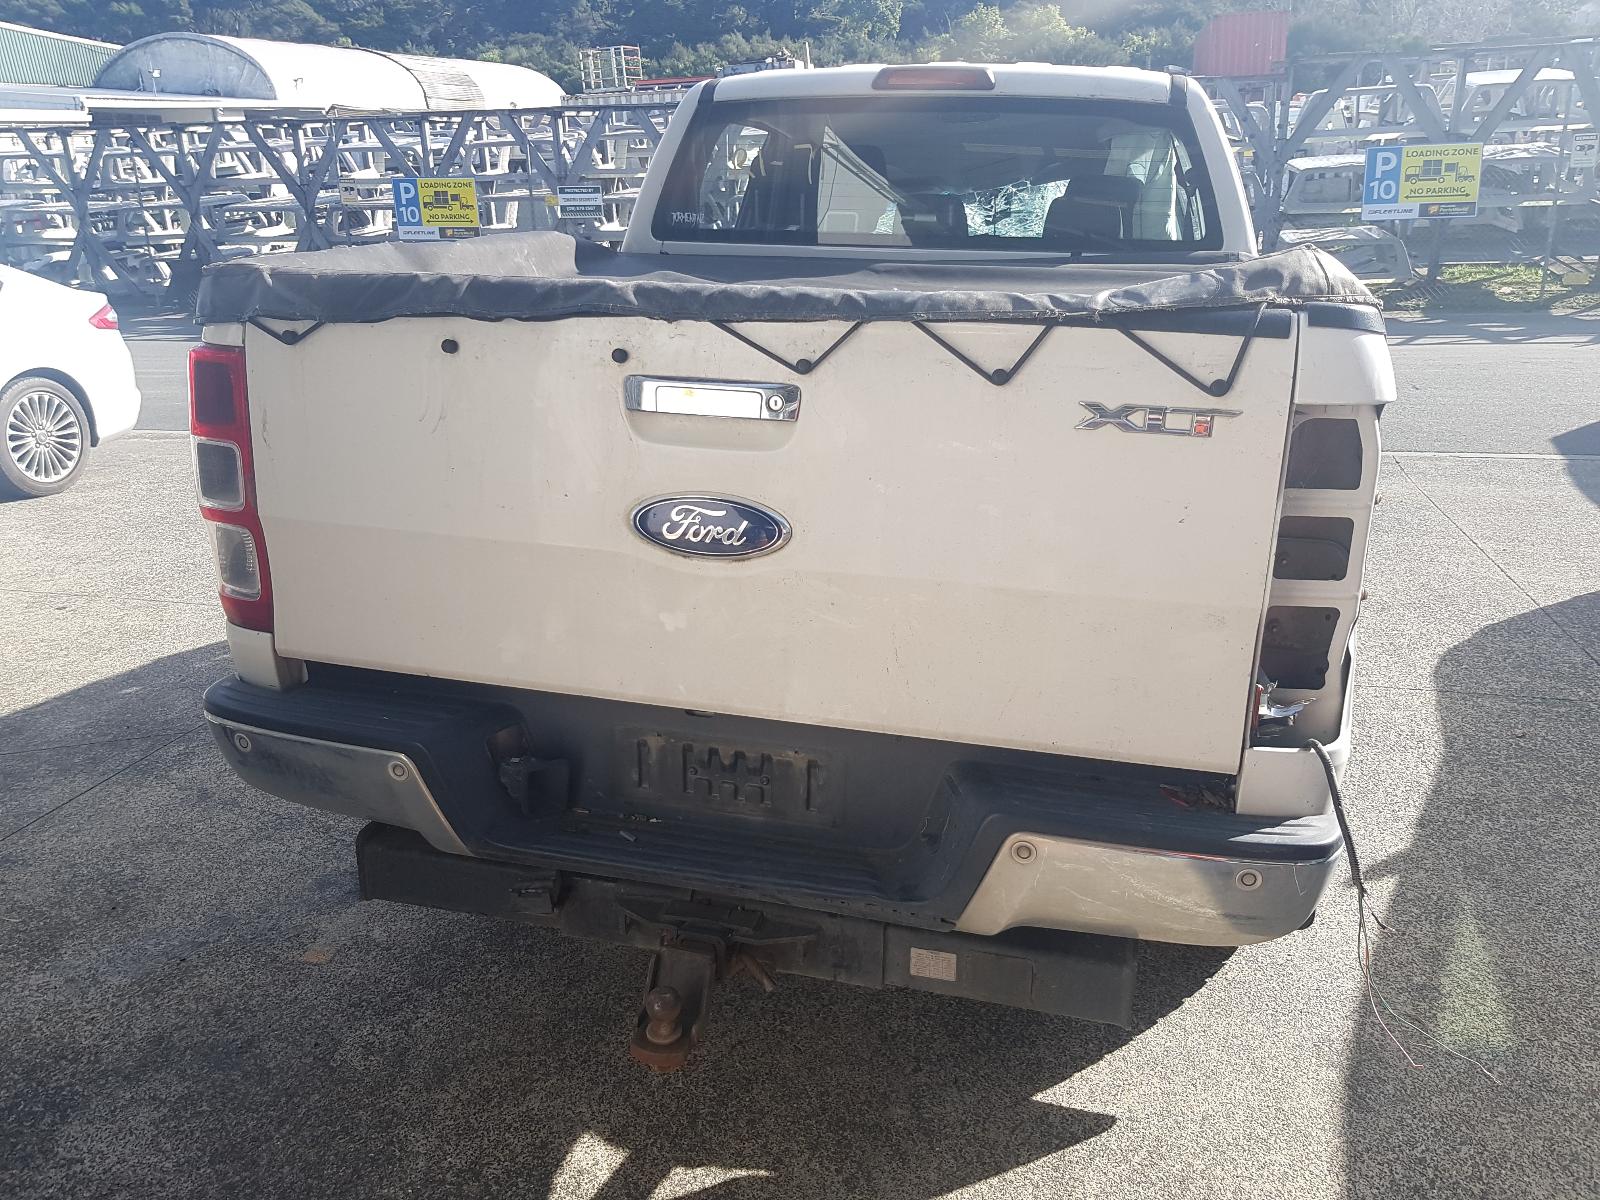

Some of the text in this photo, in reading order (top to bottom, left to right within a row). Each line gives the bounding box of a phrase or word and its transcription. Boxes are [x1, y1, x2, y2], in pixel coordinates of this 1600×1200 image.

[1406, 148, 1479, 158] LOADING ZONE
[1375, 151, 1398, 179] P
[399, 182, 416, 205] P
[1369, 180, 1396, 200] 10
[1426, 186, 1466, 195] PARKING
[399, 206, 420, 223] 10
[662, 504, 749, 546] Ford
